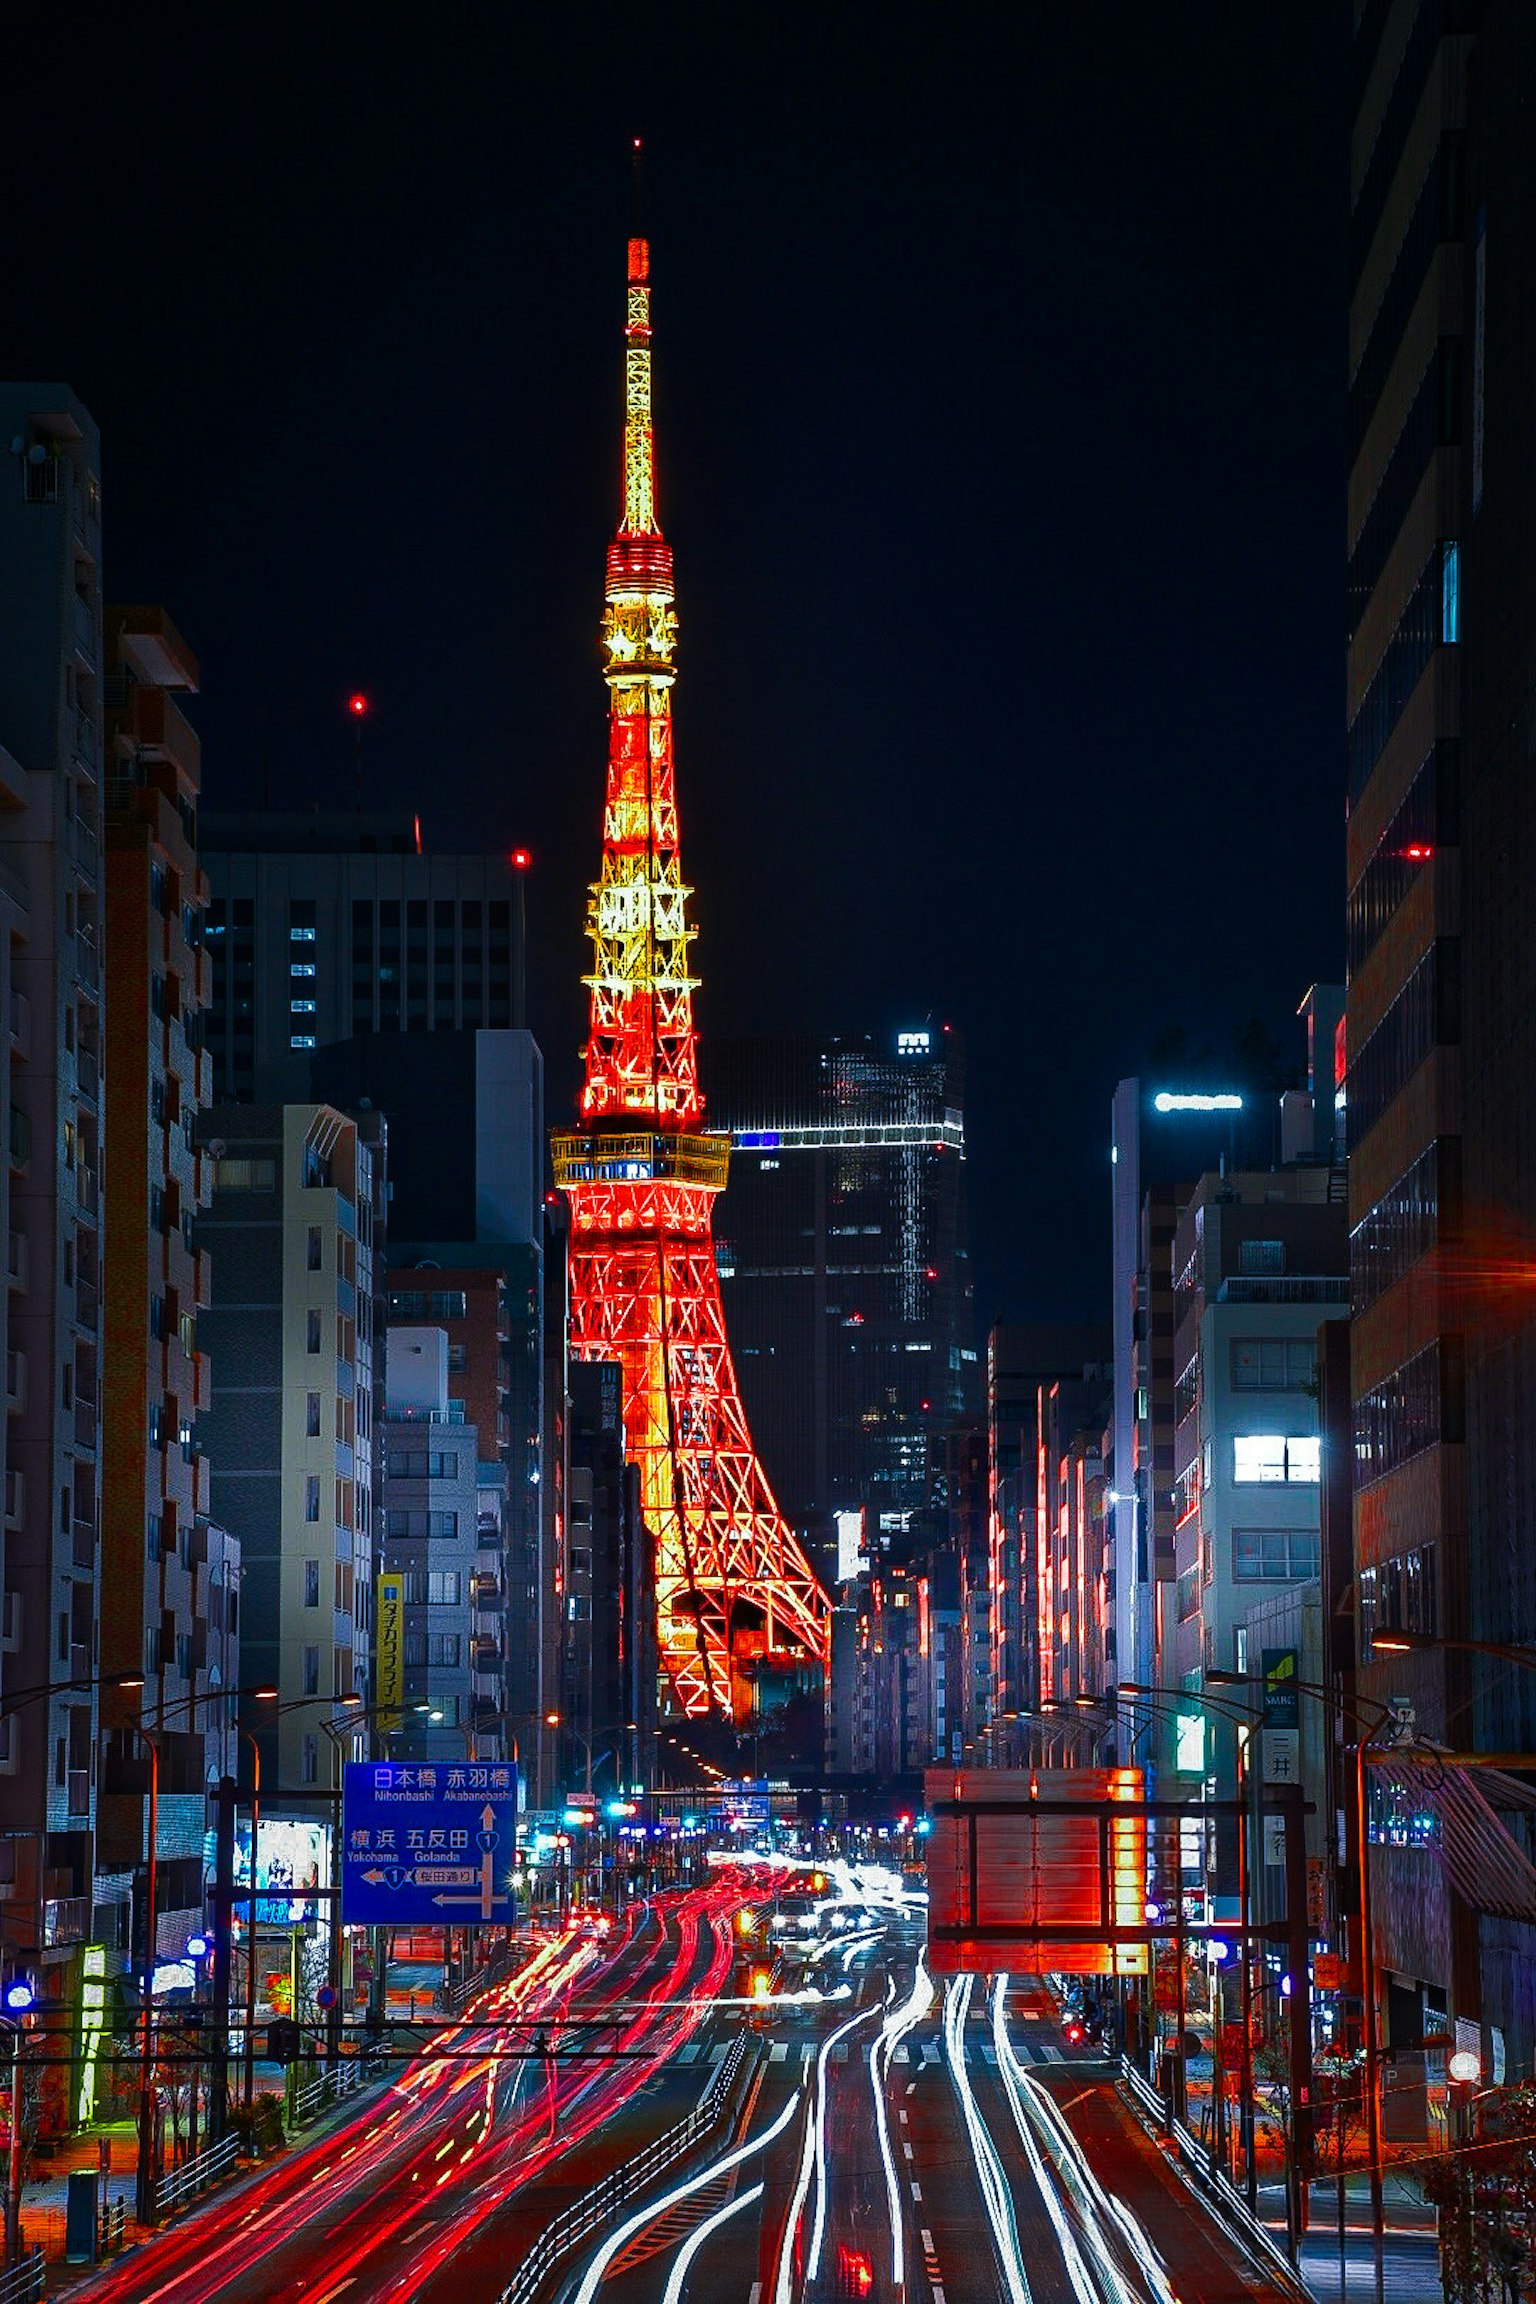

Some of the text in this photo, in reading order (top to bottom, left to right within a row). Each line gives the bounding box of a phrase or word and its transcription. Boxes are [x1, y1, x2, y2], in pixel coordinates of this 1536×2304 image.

[1265, 1695, 1296, 1705] SMBC
[1273, 1738, 1291, 1776] 三井
[374, 1768, 511, 1788] 日本橋 赤羽橋
[374, 1790, 513, 1802] Nihonbashi Akabanebashi
[351, 1829, 469, 1850] 横浜 五反田
[484, 1834, 491, 1848] 1
[347, 1851, 399, 1863] Yokohama
[391, 1869, 398, 1883] 1
[420, 1871, 470, 1883] 桜田通り
